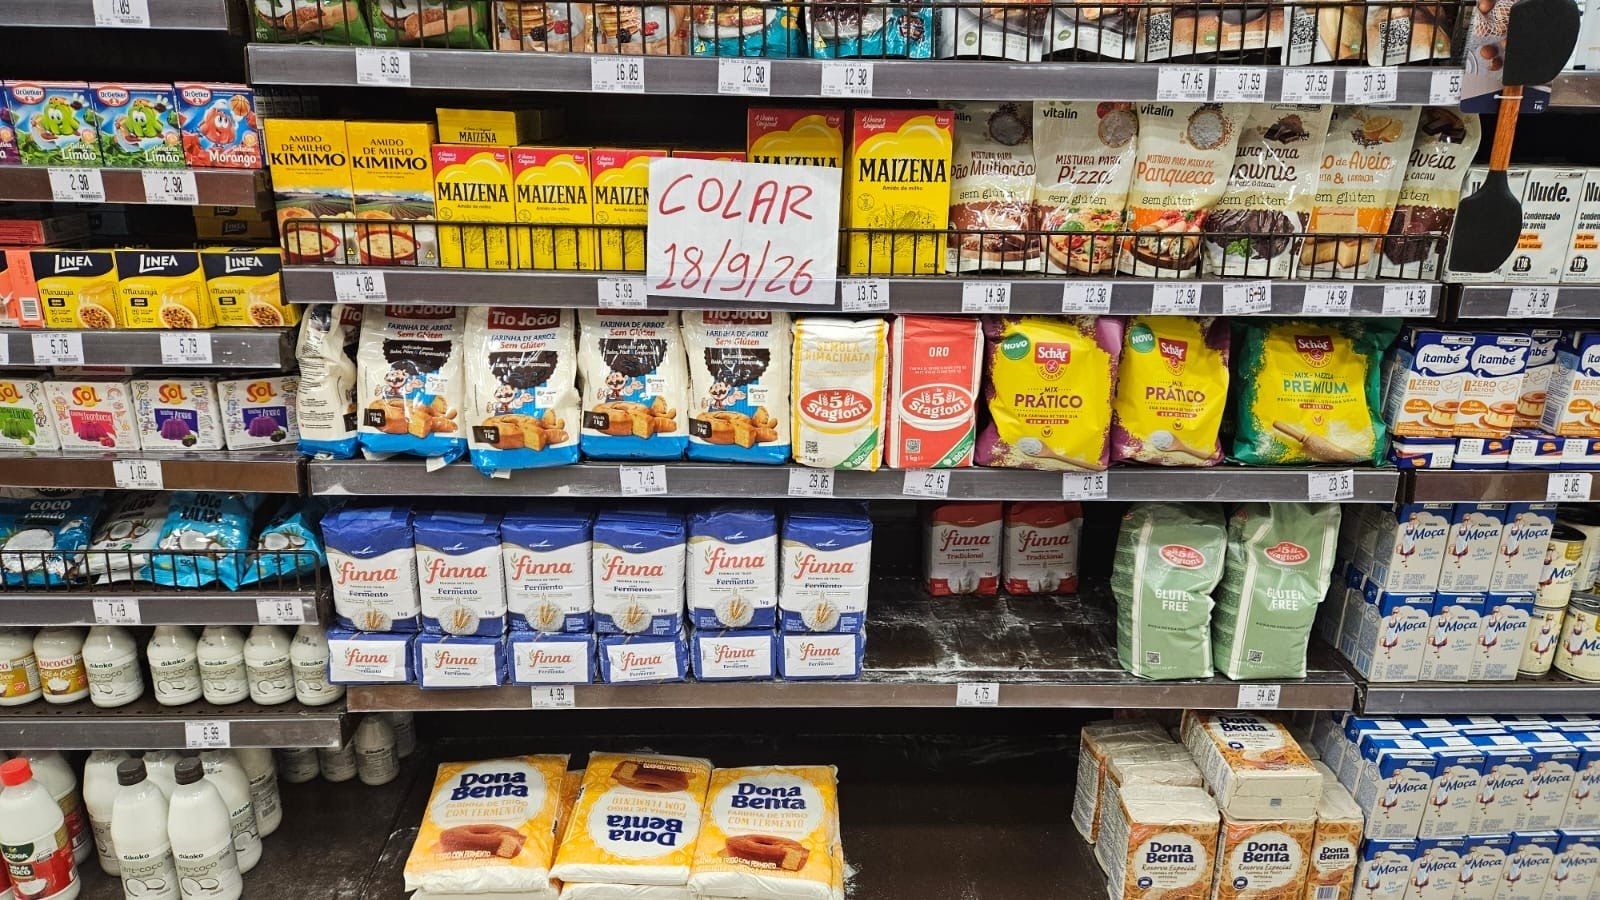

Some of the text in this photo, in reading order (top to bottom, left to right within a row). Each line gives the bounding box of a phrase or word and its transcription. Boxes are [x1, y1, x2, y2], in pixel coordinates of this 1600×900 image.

[743, 66, 765, 84] 12.90
[1238, 73, 1260, 90] 37.59
[1043, 108, 1078, 119] vitalin
[1140, 104, 1174, 118] vitalin
[289, 135, 322, 143] AMIDO
[370, 138, 404, 147] AMIDO
[459, 131, 497, 144] MAIZENA
[62, 148, 96, 161] Limão
[281, 143, 332, 153] DE MILHO
[362, 147, 414, 156] DE MILHO
[145, 149, 180, 163] Limão
[209, 151, 256, 166] Morango
[271, 152, 346, 167] KIMIMO
[1056, 154, 1095, 165] MISTURA
[1348, 150, 1393, 171] Aveia
[1408, 149, 1457, 171] Aveia
[353, 156, 427, 171] KIMIMO
[858, 158, 947, 183] MAIZENA
[1057, 166, 1113, 185] Pizza
[1137, 162, 1215, 187] Panqueca
[70, 174, 90, 191] 2.90
[163, 176, 183, 193] 2.90
[437, 182, 510, 203] MAIZENA
[517, 184, 588, 204] MAIZENA
[1528, 181, 1571, 202] Nude.
[659, 174, 813, 225] COLAR
[1071, 193, 1107, 206] glúten
[1142, 195, 1162, 206] sem
[1244, 194, 1287, 207] glúten
[54, 254, 93, 273] LINEA
[139, 254, 179, 273] LINEA
[225, 255, 263, 273] LINEA
[656, 239, 814, 298] 18/9/26
[857, 284, 878, 301] 13.75
[343, 306, 362, 321] Tio
[492, 310, 557, 327] Tio João
[643, 321, 665, 329] ARROZ
[500, 341, 546, 350] Sem Glúten
[1004, 340, 1028, 350] NOVO
[1132, 334, 1153, 344] NOVO
[1298, 338, 1329, 350] Schär
[929, 346, 950, 358] ORO
[1038, 346, 1068, 361] Schär
[1161, 343, 1184, 359] Schär
[1423, 352, 1460, 364] itambé
[1478, 352, 1516, 365] itambé
[1283, 380, 1348, 394] PREMIUM
[1416, 379, 1440, 387] ZERO
[1014, 392, 1083, 409] PRÁTICO
[1145, 386, 1205, 404] PRÁTICO
[806, 404, 868, 424] Stagioni
[909, 400, 968, 419] Stagioni
[940, 530, 991, 552] finna
[1018, 530, 1070, 552] finna
[1412, 528, 1446, 541] Moça
[1465, 528, 1499, 542] Moça
[705, 547, 765, 575] finna
[947, 552, 984, 560] Tradicional
[1026, 552, 1064, 560] Tradicional
[337, 561, 398, 585] finna
[425, 558, 488, 584] finna
[512, 555, 573, 581] finna
[602, 555, 664, 582] finna
[793, 554, 855, 580] finna
[524, 584, 564, 592] Fermento
[613, 585, 653, 593] Fermento
[716, 578, 755, 586] Fermento
[1266, 586, 1304, 600] GLUTEN
[1162, 601, 1189, 612] FREE
[1272, 600, 1299, 611] FREE
[1395, 620, 1428, 634] Moça
[1494, 620, 1527, 634] Moça
[348, 648, 389, 667] finna
[1217, 714, 1259, 725] Dona
[1221, 723, 1268, 732] Benta
[460, 771, 526, 788] Dona
[1493, 777, 1525, 792] Moça
[451, 781, 529, 801] Benta
[738, 782, 802, 798] Dona
[1396, 781, 1428, 795] Moça
[731, 795, 807, 810] Benta
[606, 814, 684, 833] Benta
[727, 817, 805, 828] COM FERMENTO
[609, 830, 676, 846] Dona
[1149, 841, 1192, 854] Dona
[1246, 841, 1288, 853] Dona
[1322, 846, 1349, 855] Dona
[1146, 852, 1195, 864] Benta
[1242, 852, 1290, 863] Benta
[1319, 853, 1350, 861] Benta
[1471, 857, 1502, 871] Moça
[1566, 855, 1598, 868] Moça
[1141, 863, 1197, 872] Reserva Especial
[1238, 863, 1292, 871] Reserva Especial
